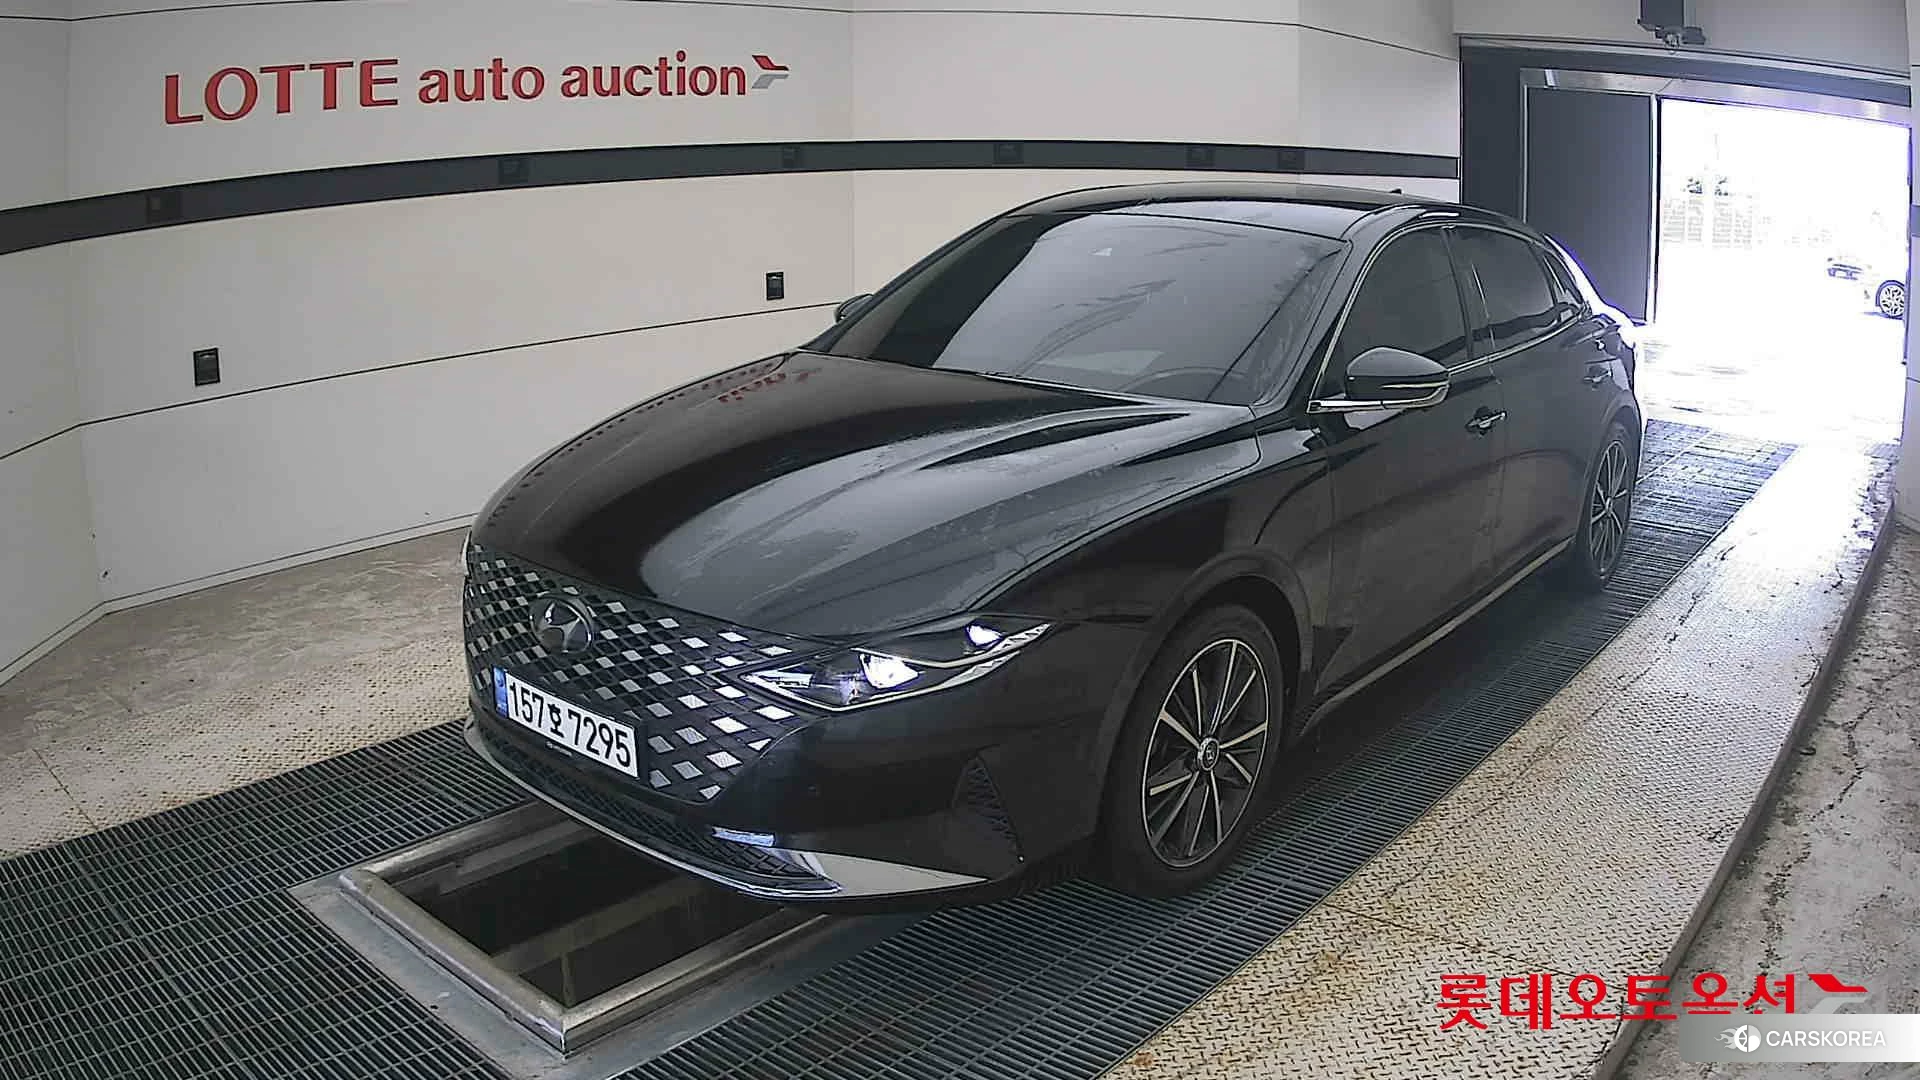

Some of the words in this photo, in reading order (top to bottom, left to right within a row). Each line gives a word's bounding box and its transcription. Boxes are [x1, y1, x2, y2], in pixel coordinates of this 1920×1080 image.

[165, 59, 398, 124] LOTTE
[418, 58, 545, 103] auto
[560, 50, 747, 98] auction
[567, 708, 631, 767] 7295
